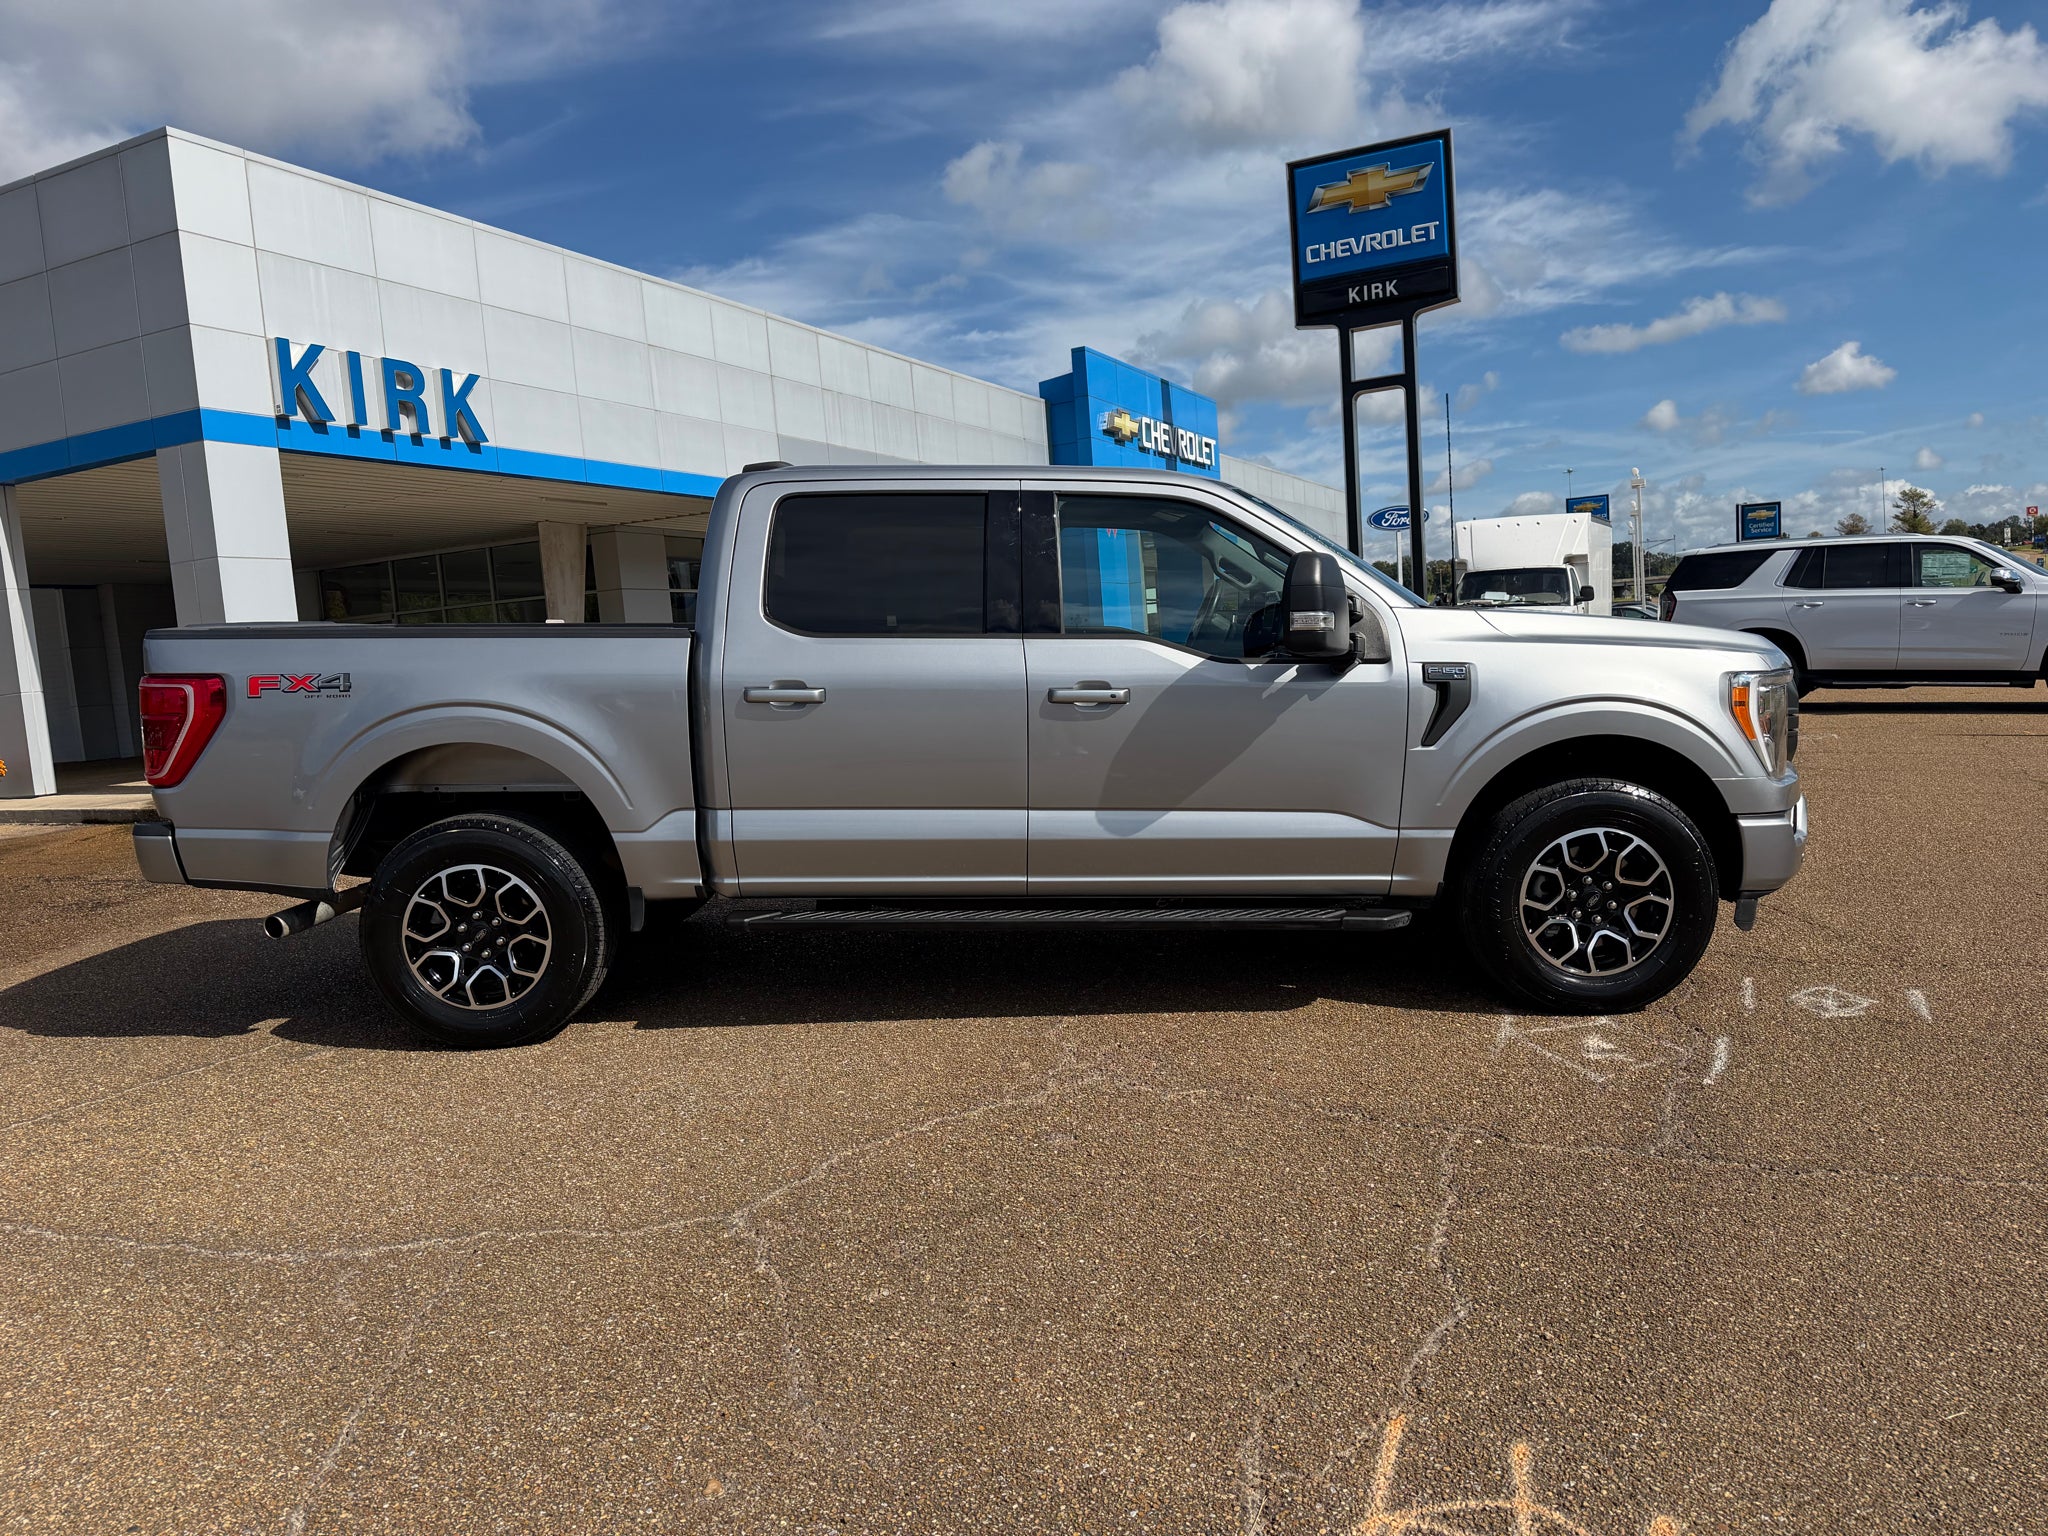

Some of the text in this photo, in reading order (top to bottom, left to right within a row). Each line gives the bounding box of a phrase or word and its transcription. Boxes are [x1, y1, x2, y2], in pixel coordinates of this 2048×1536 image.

[1305, 221, 1439, 264] CHEVROLET
[1348, 279, 1399, 304] KIRK
[270, 336, 489, 443] KIRK
[1140, 416, 1217, 466] CHEVROLET
[1749, 521, 1775, 529] Certified
[1428, 666, 1466, 674] F-150
[247, 673, 351, 698] FX4
